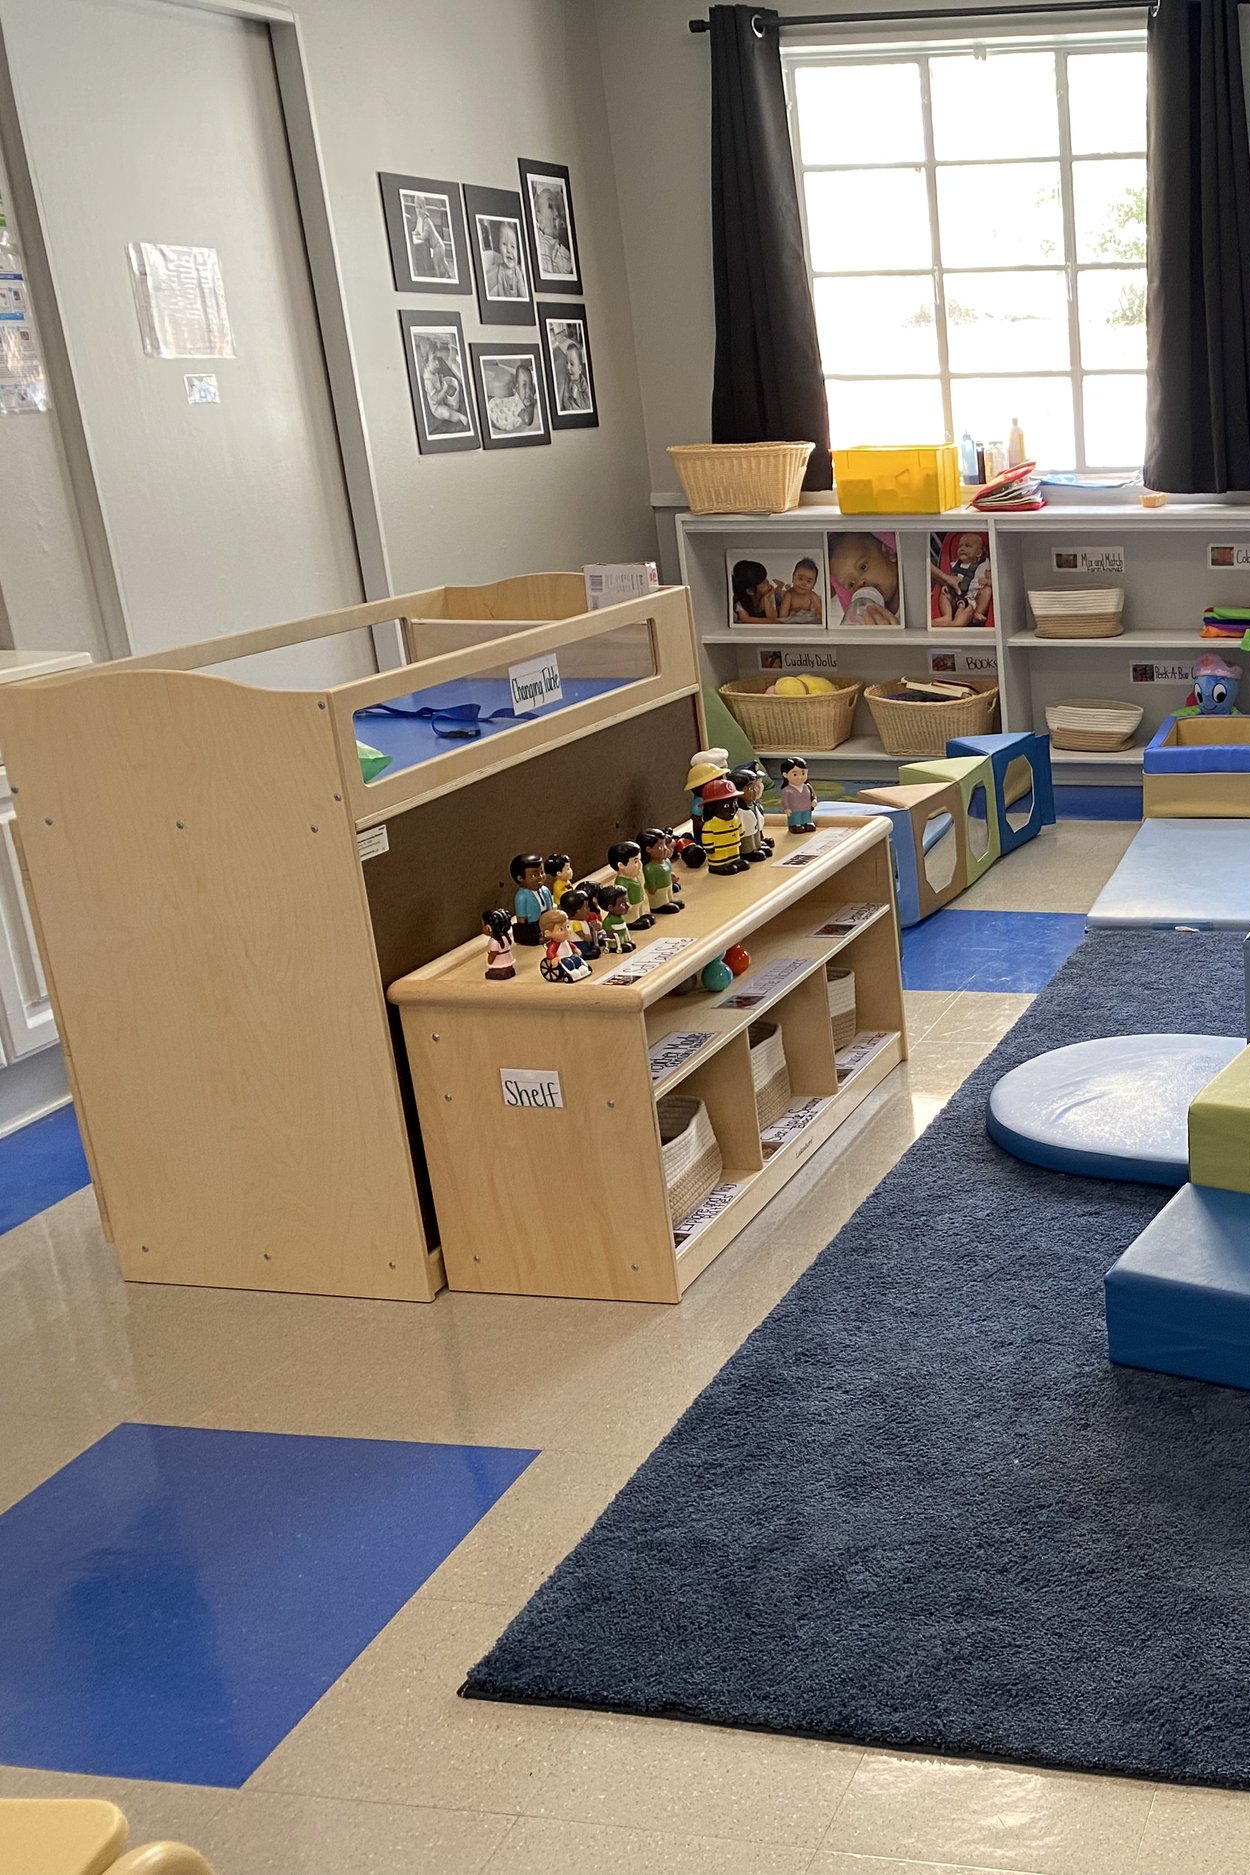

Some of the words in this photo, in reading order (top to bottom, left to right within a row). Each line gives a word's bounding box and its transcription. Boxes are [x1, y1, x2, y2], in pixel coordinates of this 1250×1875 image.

[1094, 553, 1104, 567] and
[1105, 553, 1123, 567] Match
[785, 653, 814, 668] Cuddly
[815, 653, 837, 668] Dolls
[511, 677, 545, 707] Changing
[541, 665, 560, 693] Table
[504, 1080, 559, 1107] Shelf
